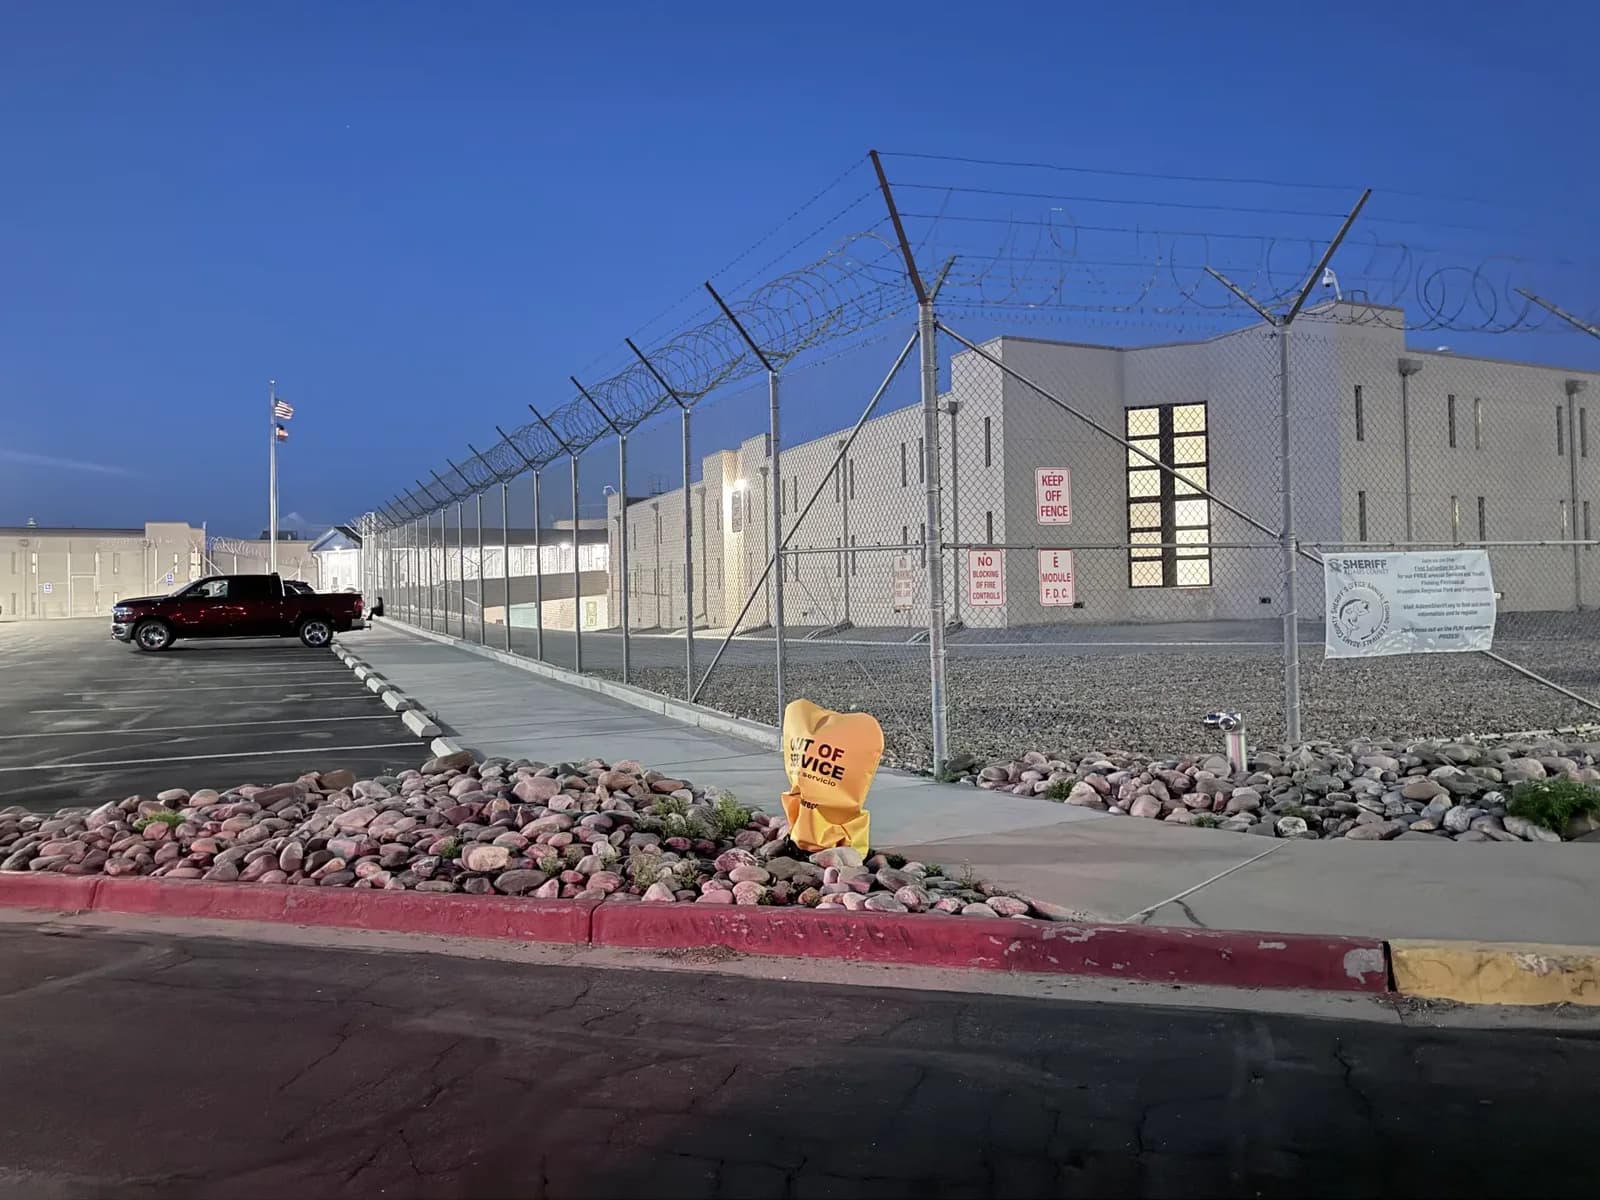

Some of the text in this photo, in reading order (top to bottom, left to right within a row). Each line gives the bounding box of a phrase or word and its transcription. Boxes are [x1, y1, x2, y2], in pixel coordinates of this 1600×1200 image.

[1041, 475, 1064, 487] KEEP
[1045, 490, 1062, 502] OFF
[1040, 505, 1068, 517] FENCE
[977, 556, 993, 567] NO
[1053, 556, 1059, 568] E
[1342, 559, 1387, 569] SHERIFF
[972, 570, 1000, 578] BLOCKING
[1041, 572, 1071, 582] MODULE
[976, 581, 996, 589] OF FIRE
[972, 592, 1000, 600] CONTROLS
[818, 744, 845, 762] OF
[802, 771, 837, 788] servicio
